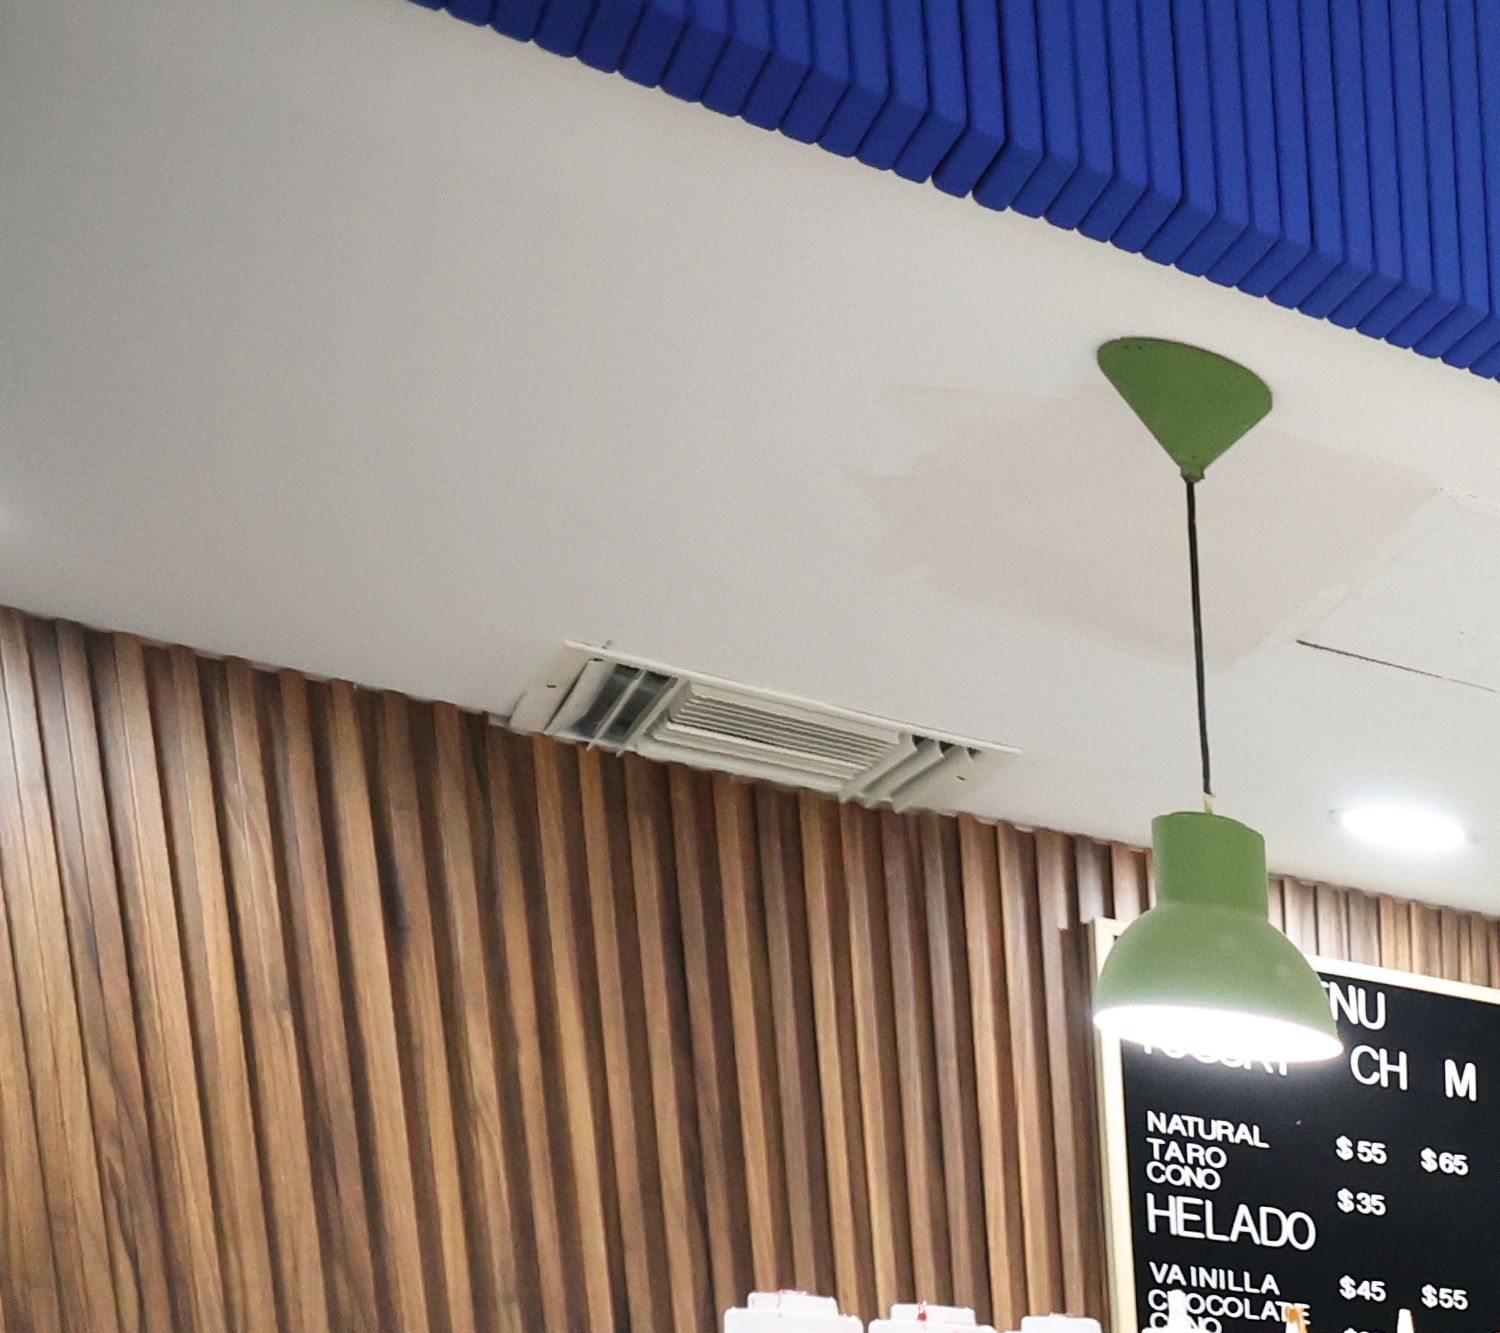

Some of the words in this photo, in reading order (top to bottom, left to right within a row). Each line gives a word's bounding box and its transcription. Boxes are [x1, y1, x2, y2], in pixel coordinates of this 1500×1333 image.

[1322, 981, 1386, 1030] NU
[1350, 1044, 1408, 1091] CH
[1444, 1058, 1477, 1101] M
[1146, 1110, 1270, 1149] NATURAL
[1335, 1135, 1387, 1164] $55
[1420, 1147, 1469, 1176] $65
[1146, 1137, 1227, 1168] TARO
[1146, 1161, 1221, 1190] CONO
[1336, 1187, 1387, 1216] $35
[1146, 1192, 1317, 1251] HELADO
[1148, 1289, 1311, 1325] COCOLATE
[1149, 1261, 1280, 1295] VAINILLA
[1339, 1274, 1387, 1302] $45
[1421, 1283, 1469, 1311] $55
